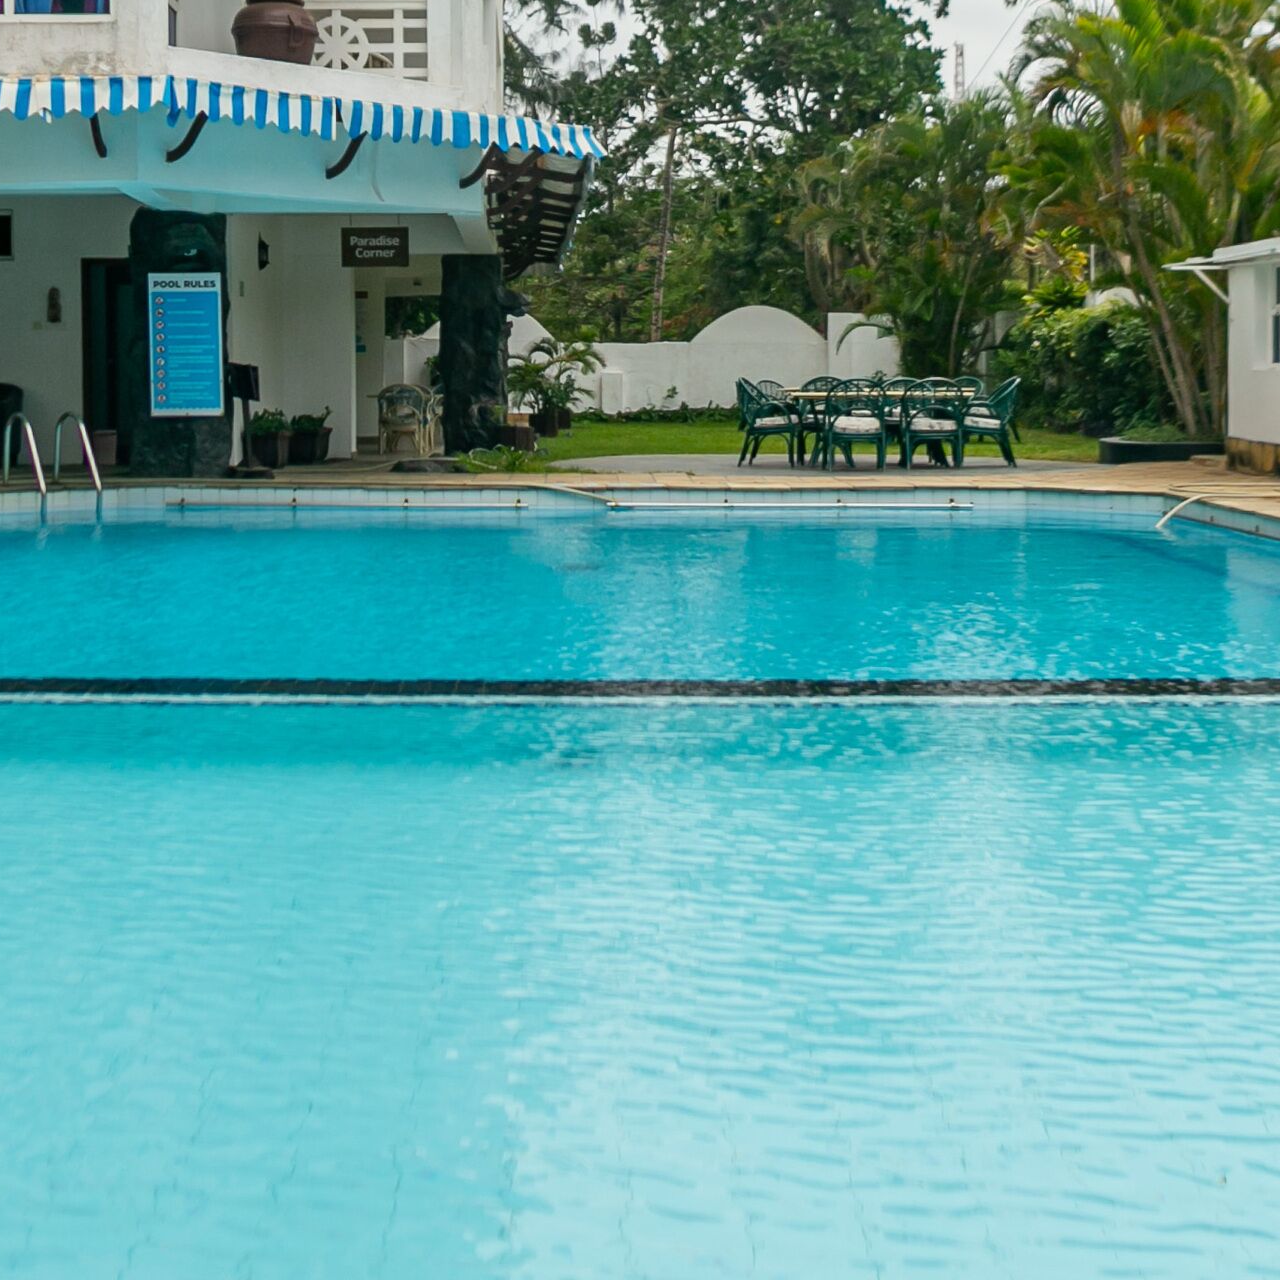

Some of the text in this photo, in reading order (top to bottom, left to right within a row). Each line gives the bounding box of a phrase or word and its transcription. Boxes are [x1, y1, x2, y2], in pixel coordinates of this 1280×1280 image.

[350, 235, 400, 246] Paradise
[355, 248, 395, 258] Corner
[153, 280, 216, 288] POOL RULES
